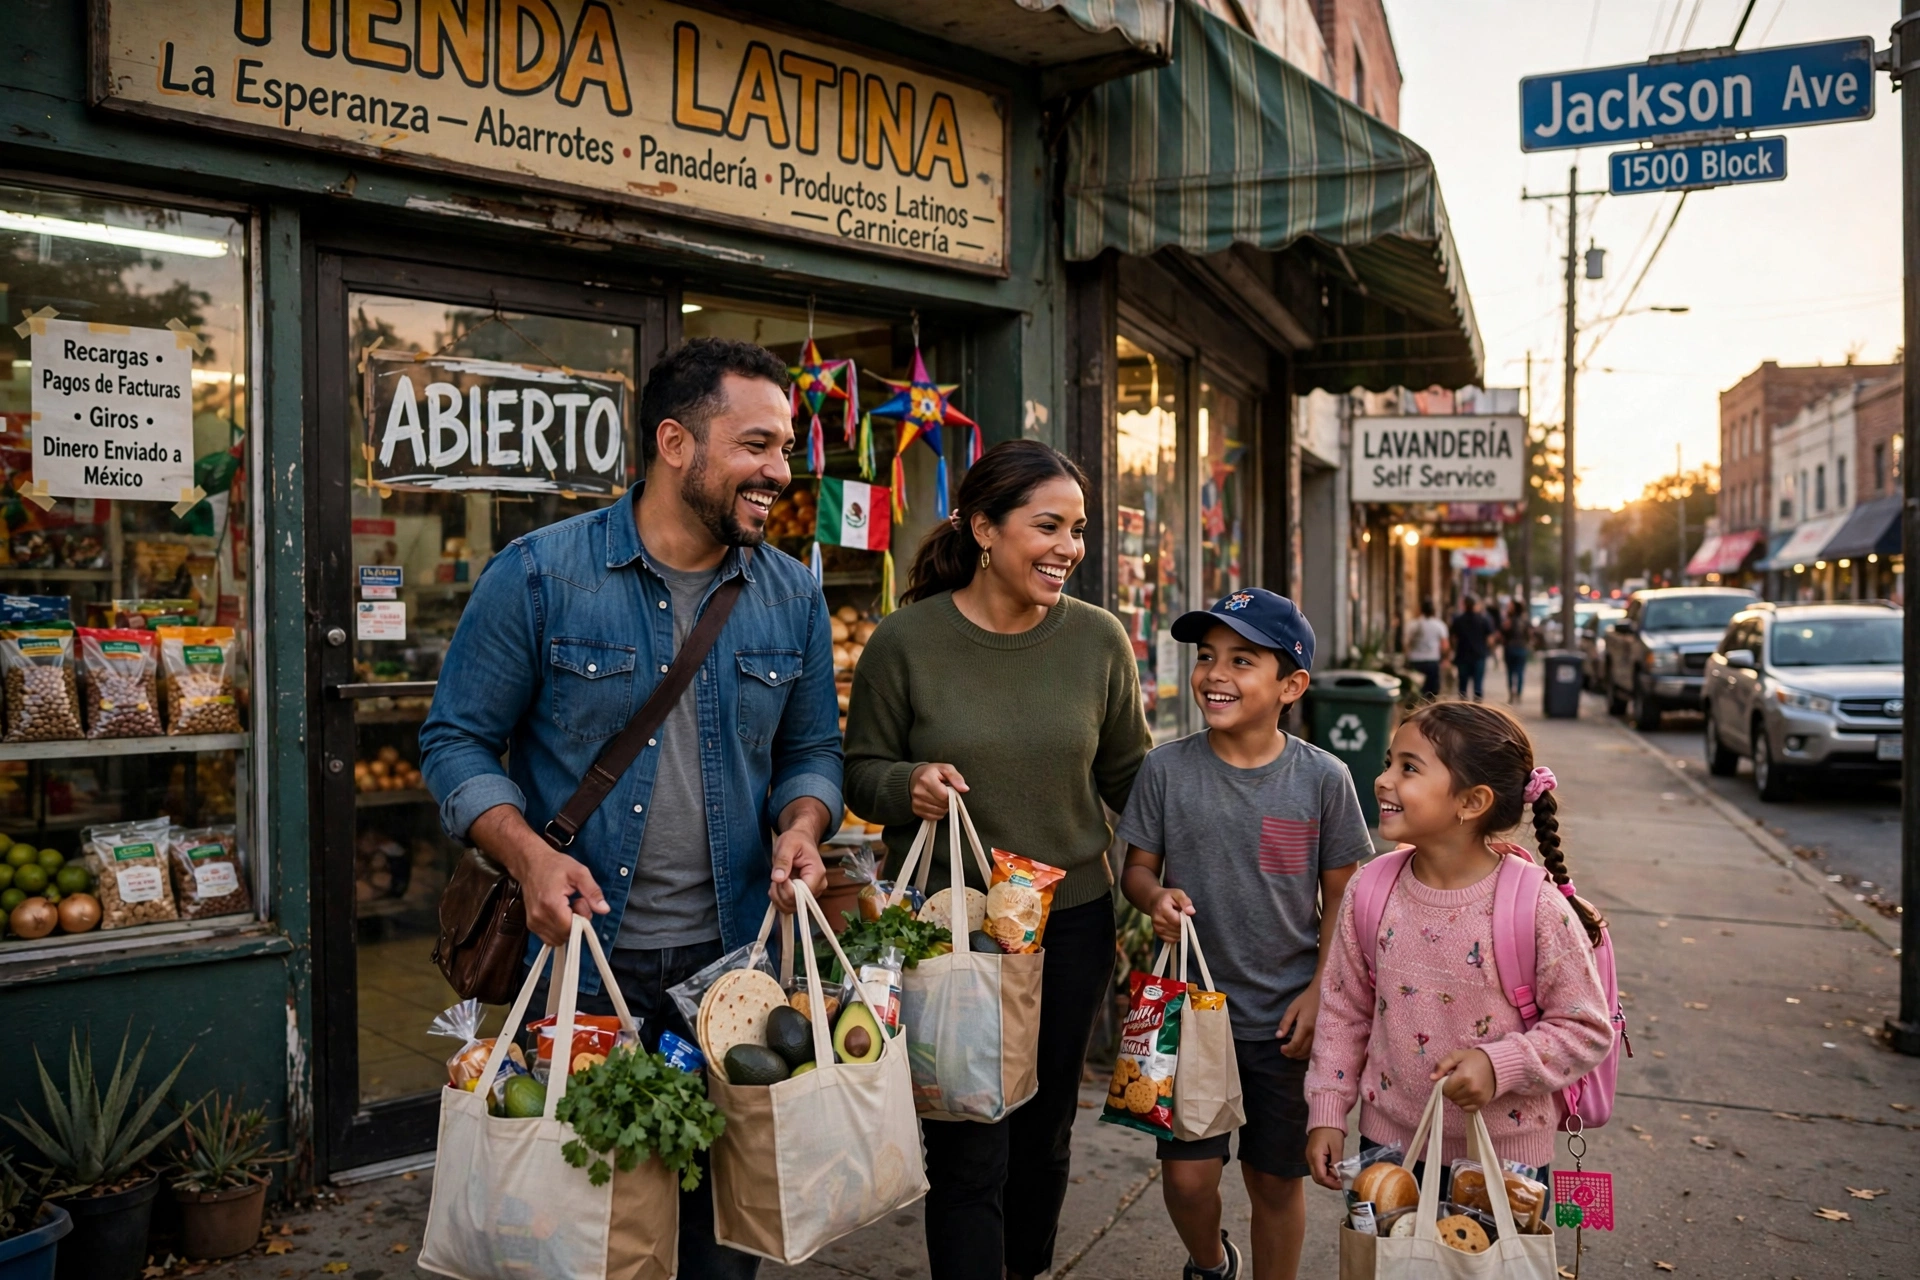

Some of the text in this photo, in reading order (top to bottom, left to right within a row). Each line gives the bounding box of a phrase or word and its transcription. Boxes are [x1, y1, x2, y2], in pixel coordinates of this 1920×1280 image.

[672, 20, 969, 188] LATINA
[1534, 64, 1858, 138] Jackson Ave
[161, 41, 969, 229] La Esperanza Abarrotes Panadería Productos Latinos
[1620, 146, 1773, 188] 1500 Block
[836, 207, 950, 254] Carnicería
[63, 339, 149, 370] Recargas
[42, 369, 181, 399] Pagos de Facturas
[89, 406, 139, 429] Giros
[378, 374, 622, 474] ABIERTO
[43, 436, 182, 463] Dinero Enviado a
[1363, 421, 1513, 460] LAVANDERÍA
[84, 464, 143, 487] México
[1372, 464, 1497, 487] Self Service
